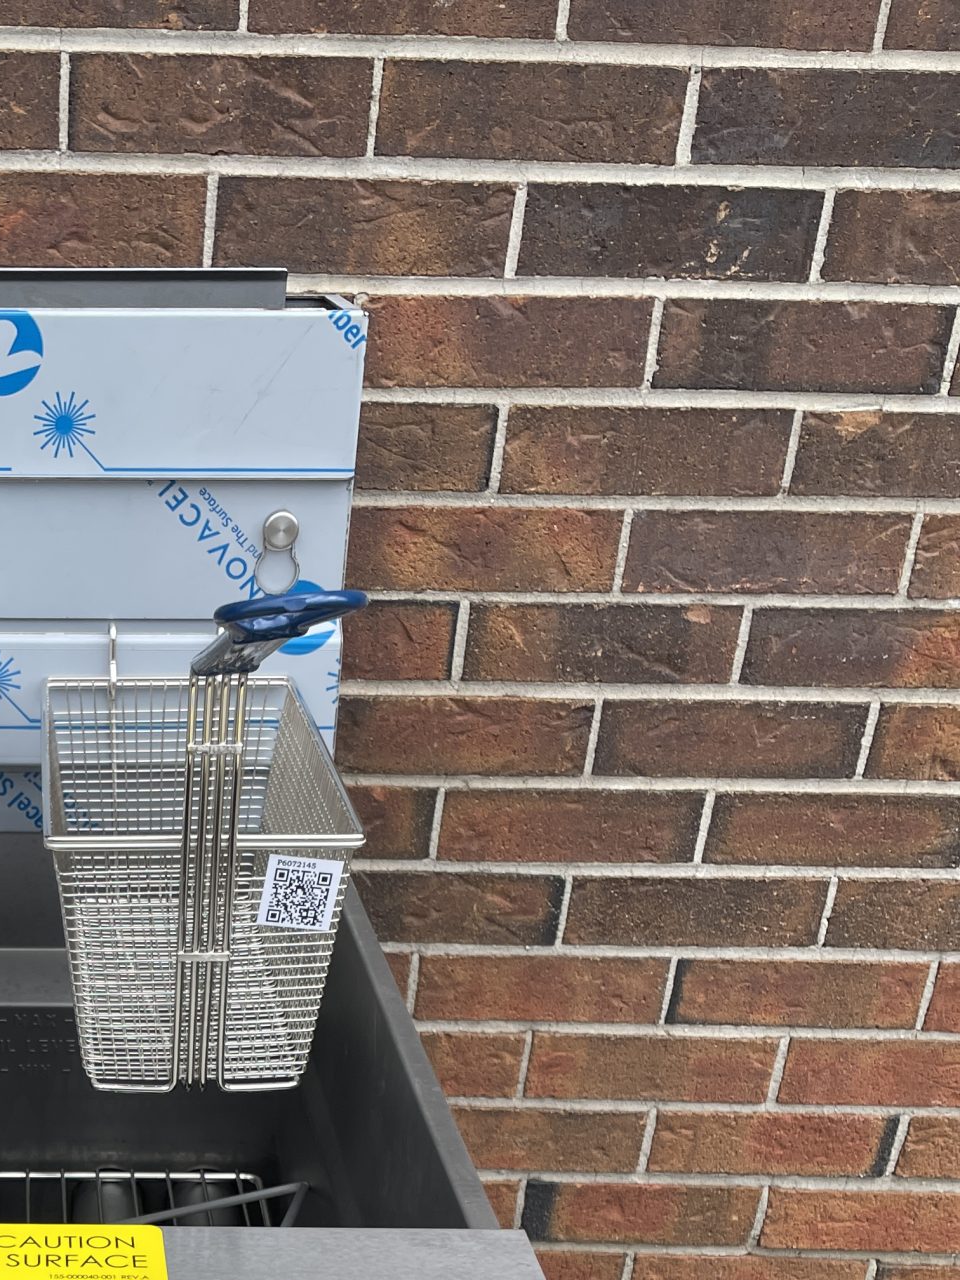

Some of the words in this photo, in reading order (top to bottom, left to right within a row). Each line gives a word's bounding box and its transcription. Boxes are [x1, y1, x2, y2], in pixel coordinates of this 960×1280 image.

[199, 487, 233, 527] Surface
[277, 859, 317, 869] P6072145
[6, 1253, 148, 1269] SURFACE
